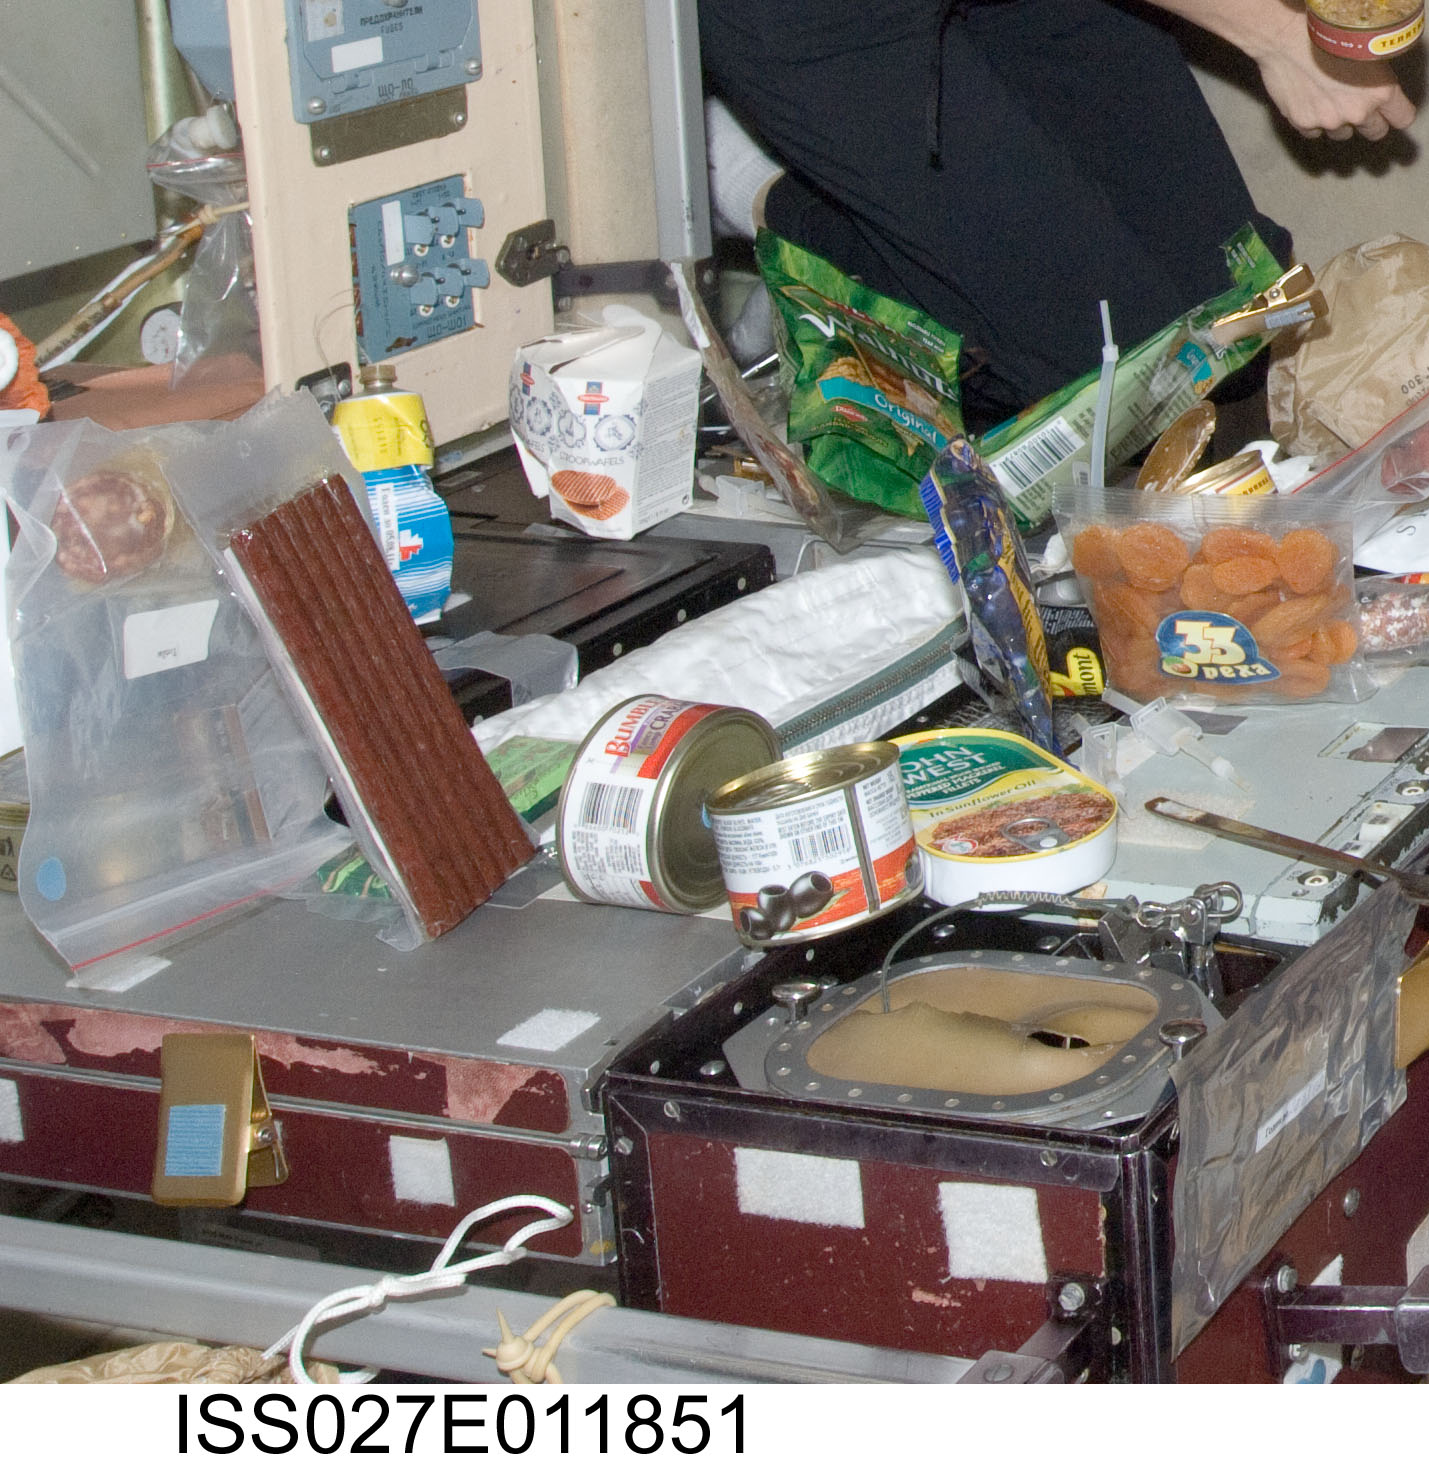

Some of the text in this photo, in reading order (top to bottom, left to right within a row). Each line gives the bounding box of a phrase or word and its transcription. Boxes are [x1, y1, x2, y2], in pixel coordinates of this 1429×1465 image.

[874, 393, 937, 443] Original
[1175, 619, 1246, 665] 33
[900, 745, 973, 774] OHN
[903, 752, 985, 786] WEST
[952, 764, 1006, 787] MACKEREL
[942, 778, 982, 795] FILLETS
[949, 786, 1013, 814] Sunflower
[1014, 779, 1037, 792] Oil
